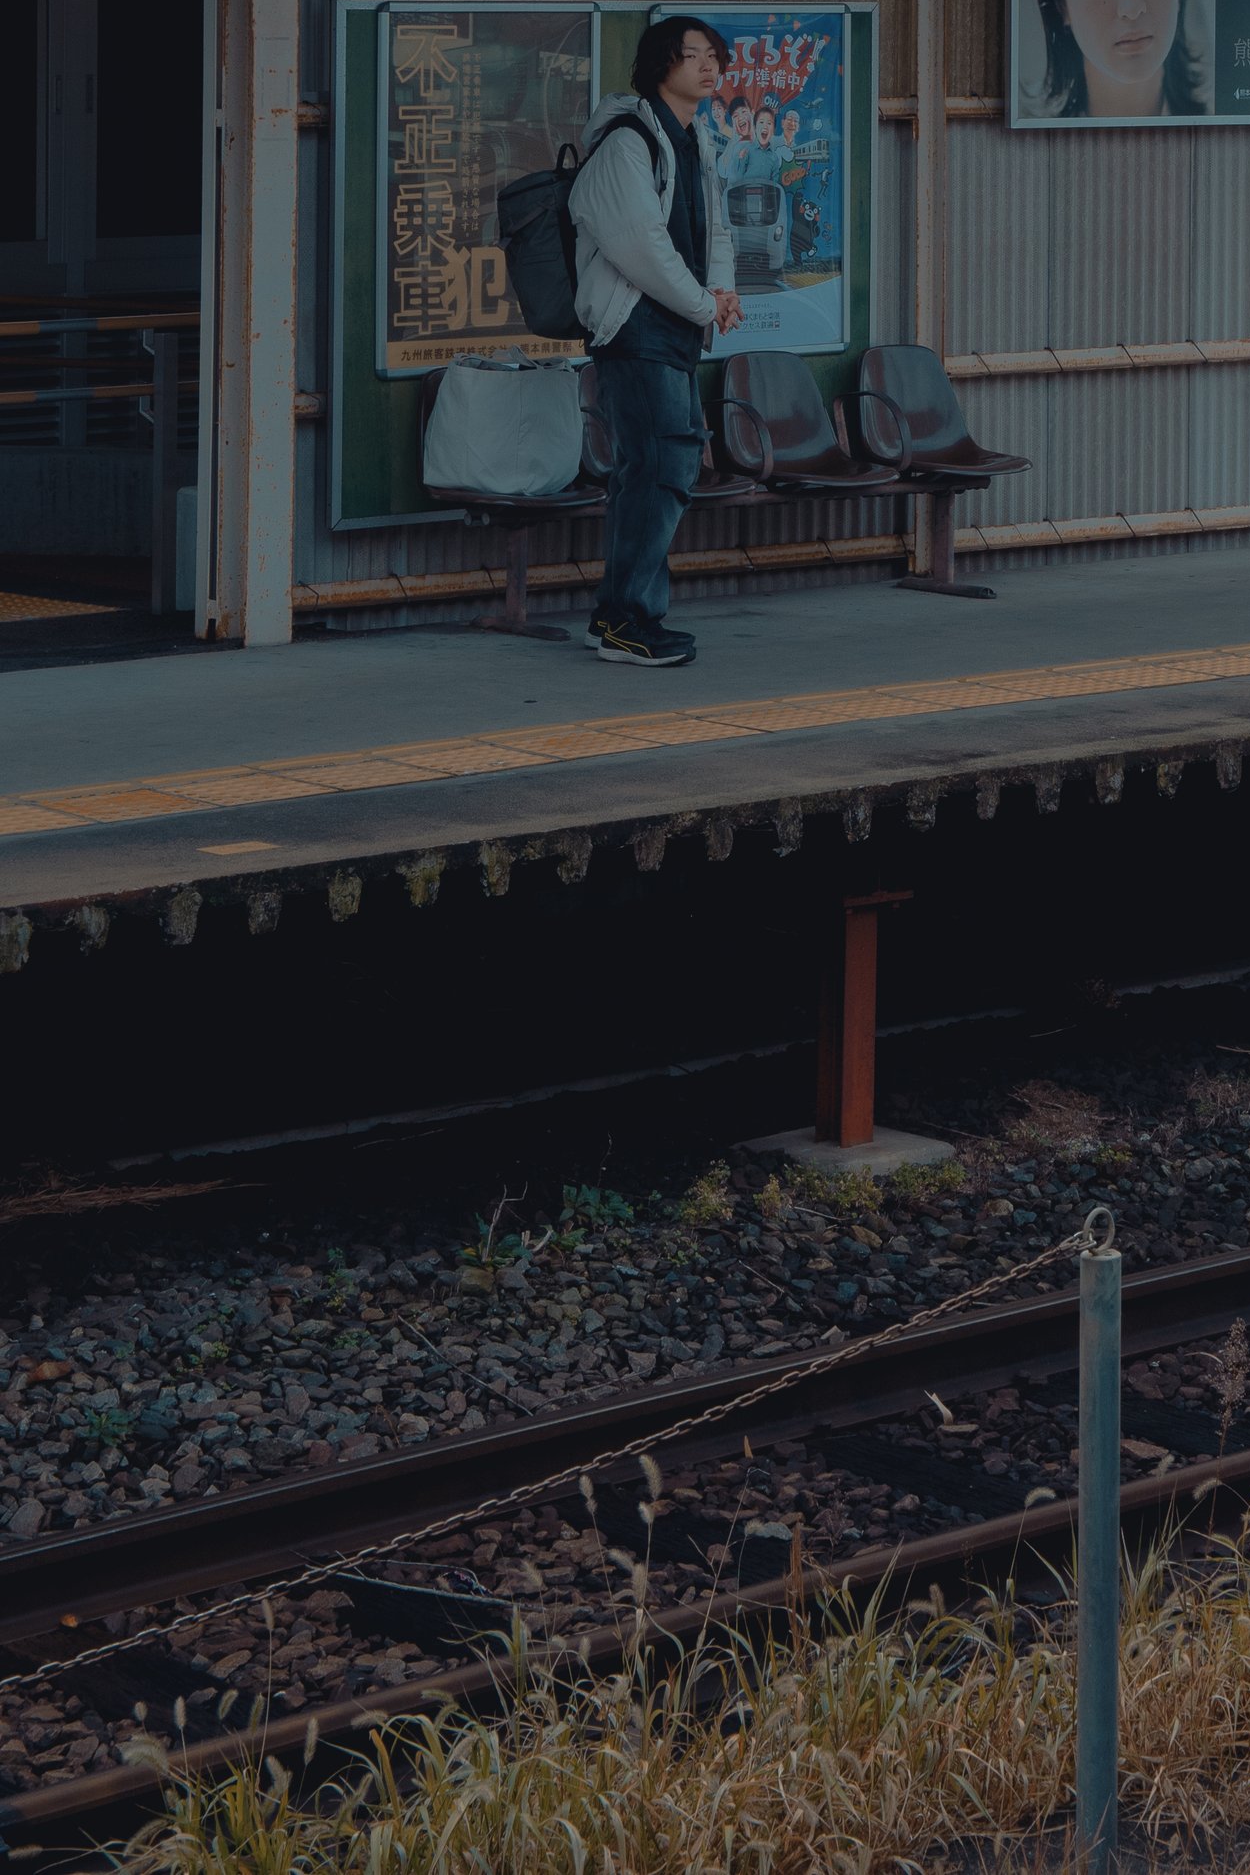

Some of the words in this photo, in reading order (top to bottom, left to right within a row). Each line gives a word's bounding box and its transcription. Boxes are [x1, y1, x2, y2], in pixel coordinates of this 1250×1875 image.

[393, 24, 457, 335] 不正乗車
[440, 245, 522, 331] 犯
